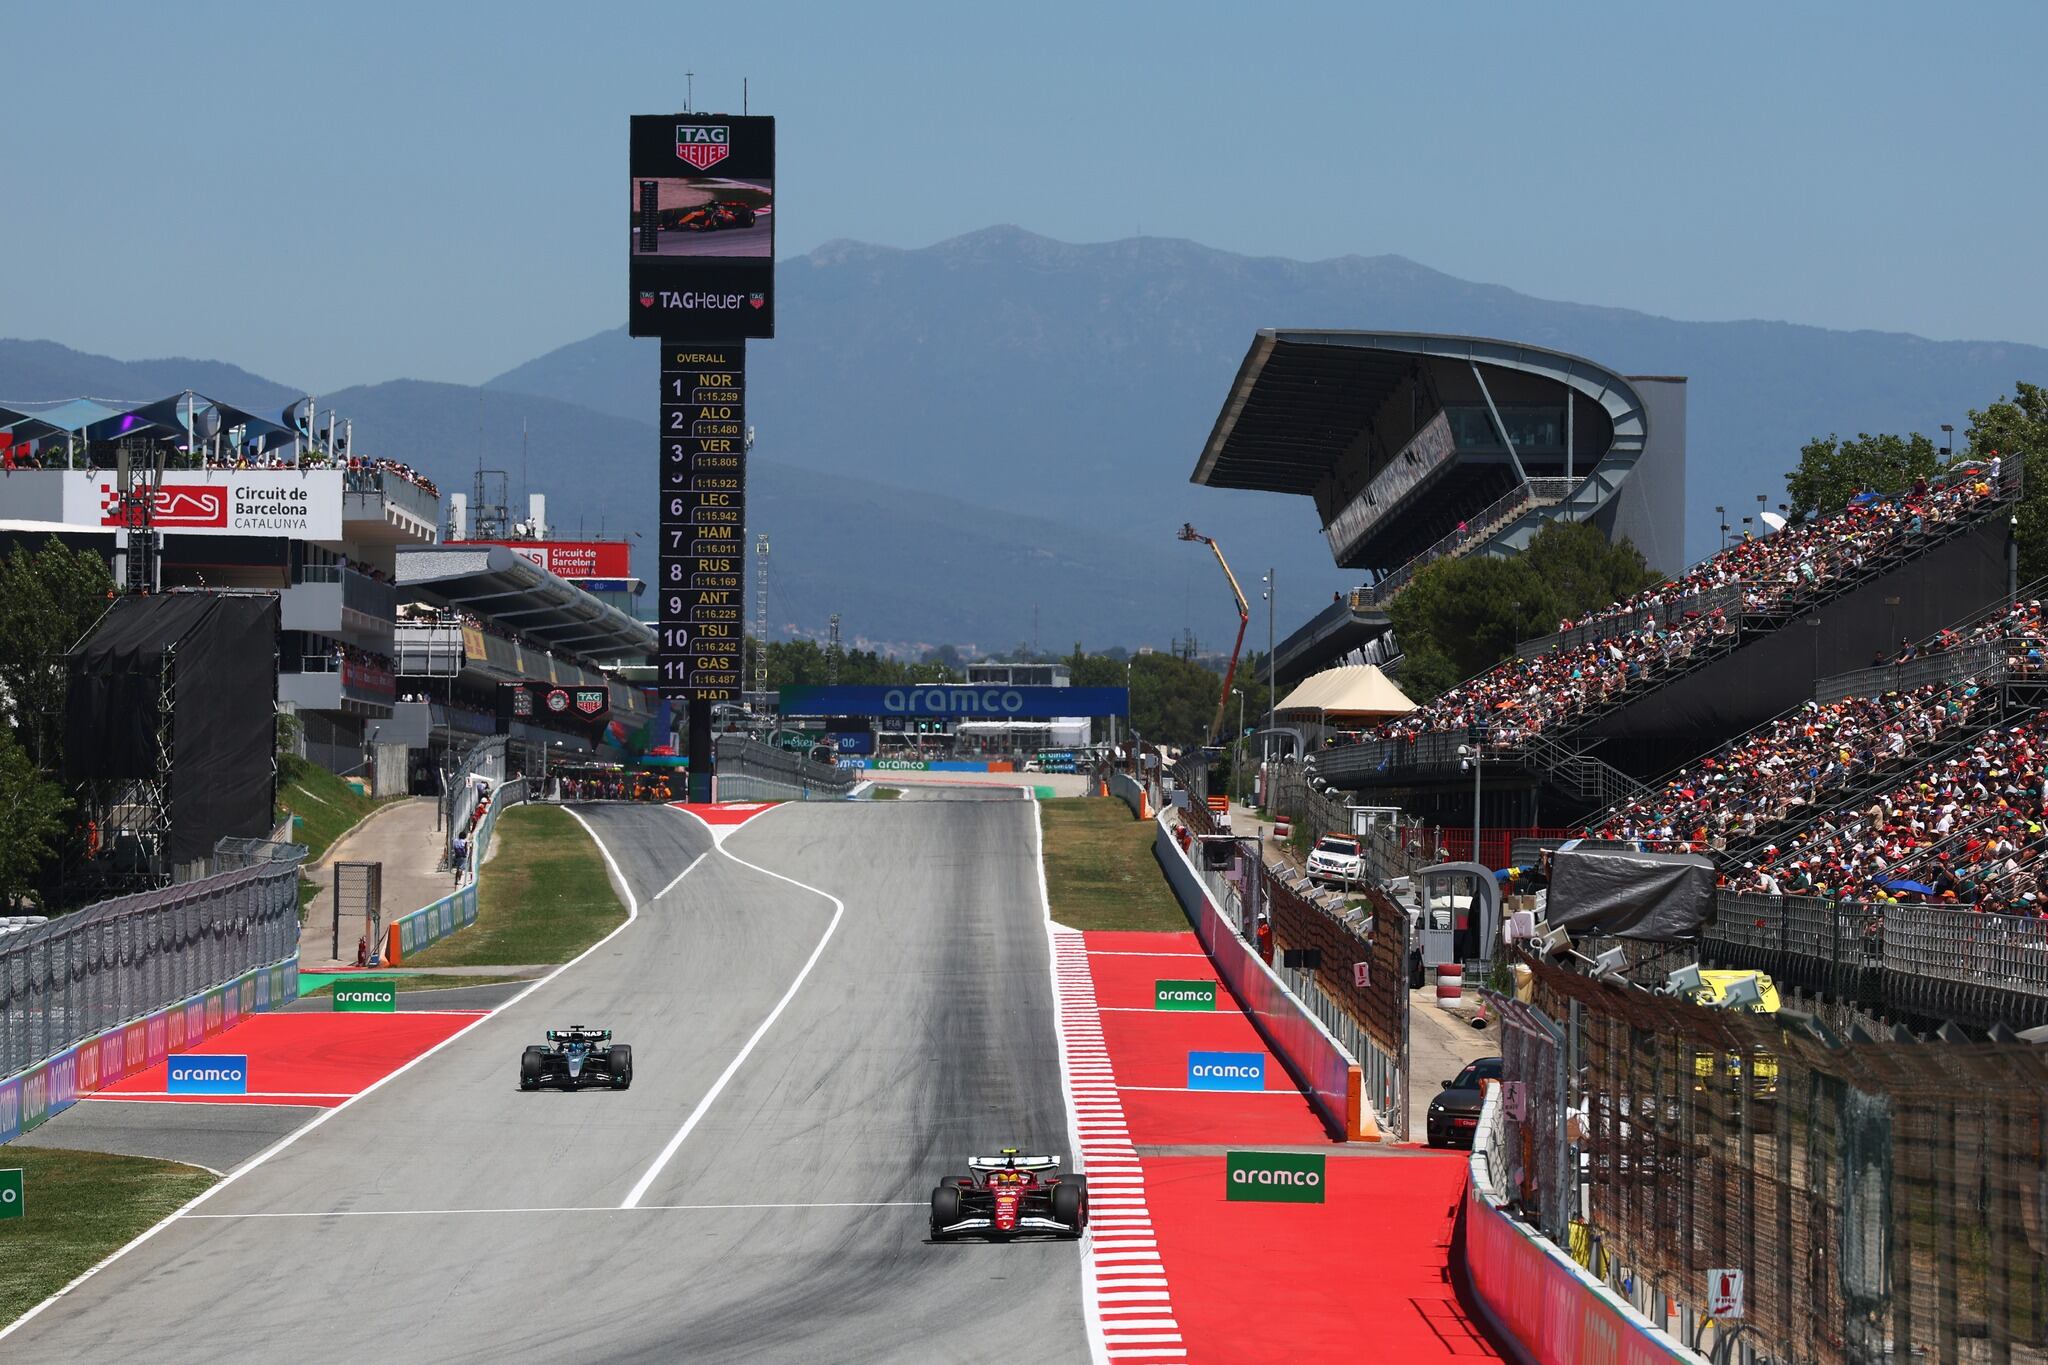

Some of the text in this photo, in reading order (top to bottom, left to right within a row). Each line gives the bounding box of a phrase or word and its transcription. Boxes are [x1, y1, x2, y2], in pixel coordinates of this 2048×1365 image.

[681, 129, 724, 142] TAG
[680, 146, 726, 166] HEUER
[677, 354, 725, 363] OVERALL
[672, 375, 732, 396] 1 NOR
[698, 393, 738, 401] 1:15.259
[671, 408, 731, 429] 2 ALO
[698, 425, 738, 434] 1:15.480
[671, 440, 730, 462] 3 VER
[697, 458, 737, 467] 1:15.805
[697, 479, 737, 488] 1:15.922
[236, 486, 307, 500] Circuit de
[236, 502, 307, 515] Barcelona
[671, 494, 729, 516] 6 LEC
[697, 512, 737, 521] 1:15.942
[235, 518, 307, 529] CATALUNYA
[671, 527, 731, 548] 7 HAM
[552, 548, 596, 557] Circuit de
[697, 545, 736, 553] 1:16.011
[552, 558, 596, 566] Barcelona
[670, 560, 730, 581] 8 RUS
[696, 577, 736, 586] 1:16.169
[670, 592, 729, 614] 9 ANT
[696, 610, 736, 619] 1:16.225
[664, 625, 728, 647] 10 TSU
[695, 643, 736, 651] 1:16.242
[664, 657, 729, 679] 11 GAS
[695, 675, 735, 684] 1:16.487
[884, 690, 1023, 712] aramco
[887, 719, 900, 727] FIA
[878, 761, 924, 770] aramco
[337, 992, 391, 1002] aramco
[1159, 991, 1212, 1001] aramco
[172, 1069, 241, 1081] aramco
[1193, 1065, 1260, 1078] aramco
[50, 1057, 76, 1105] aramco
[1233, 1169, 1319, 1186] aramco
